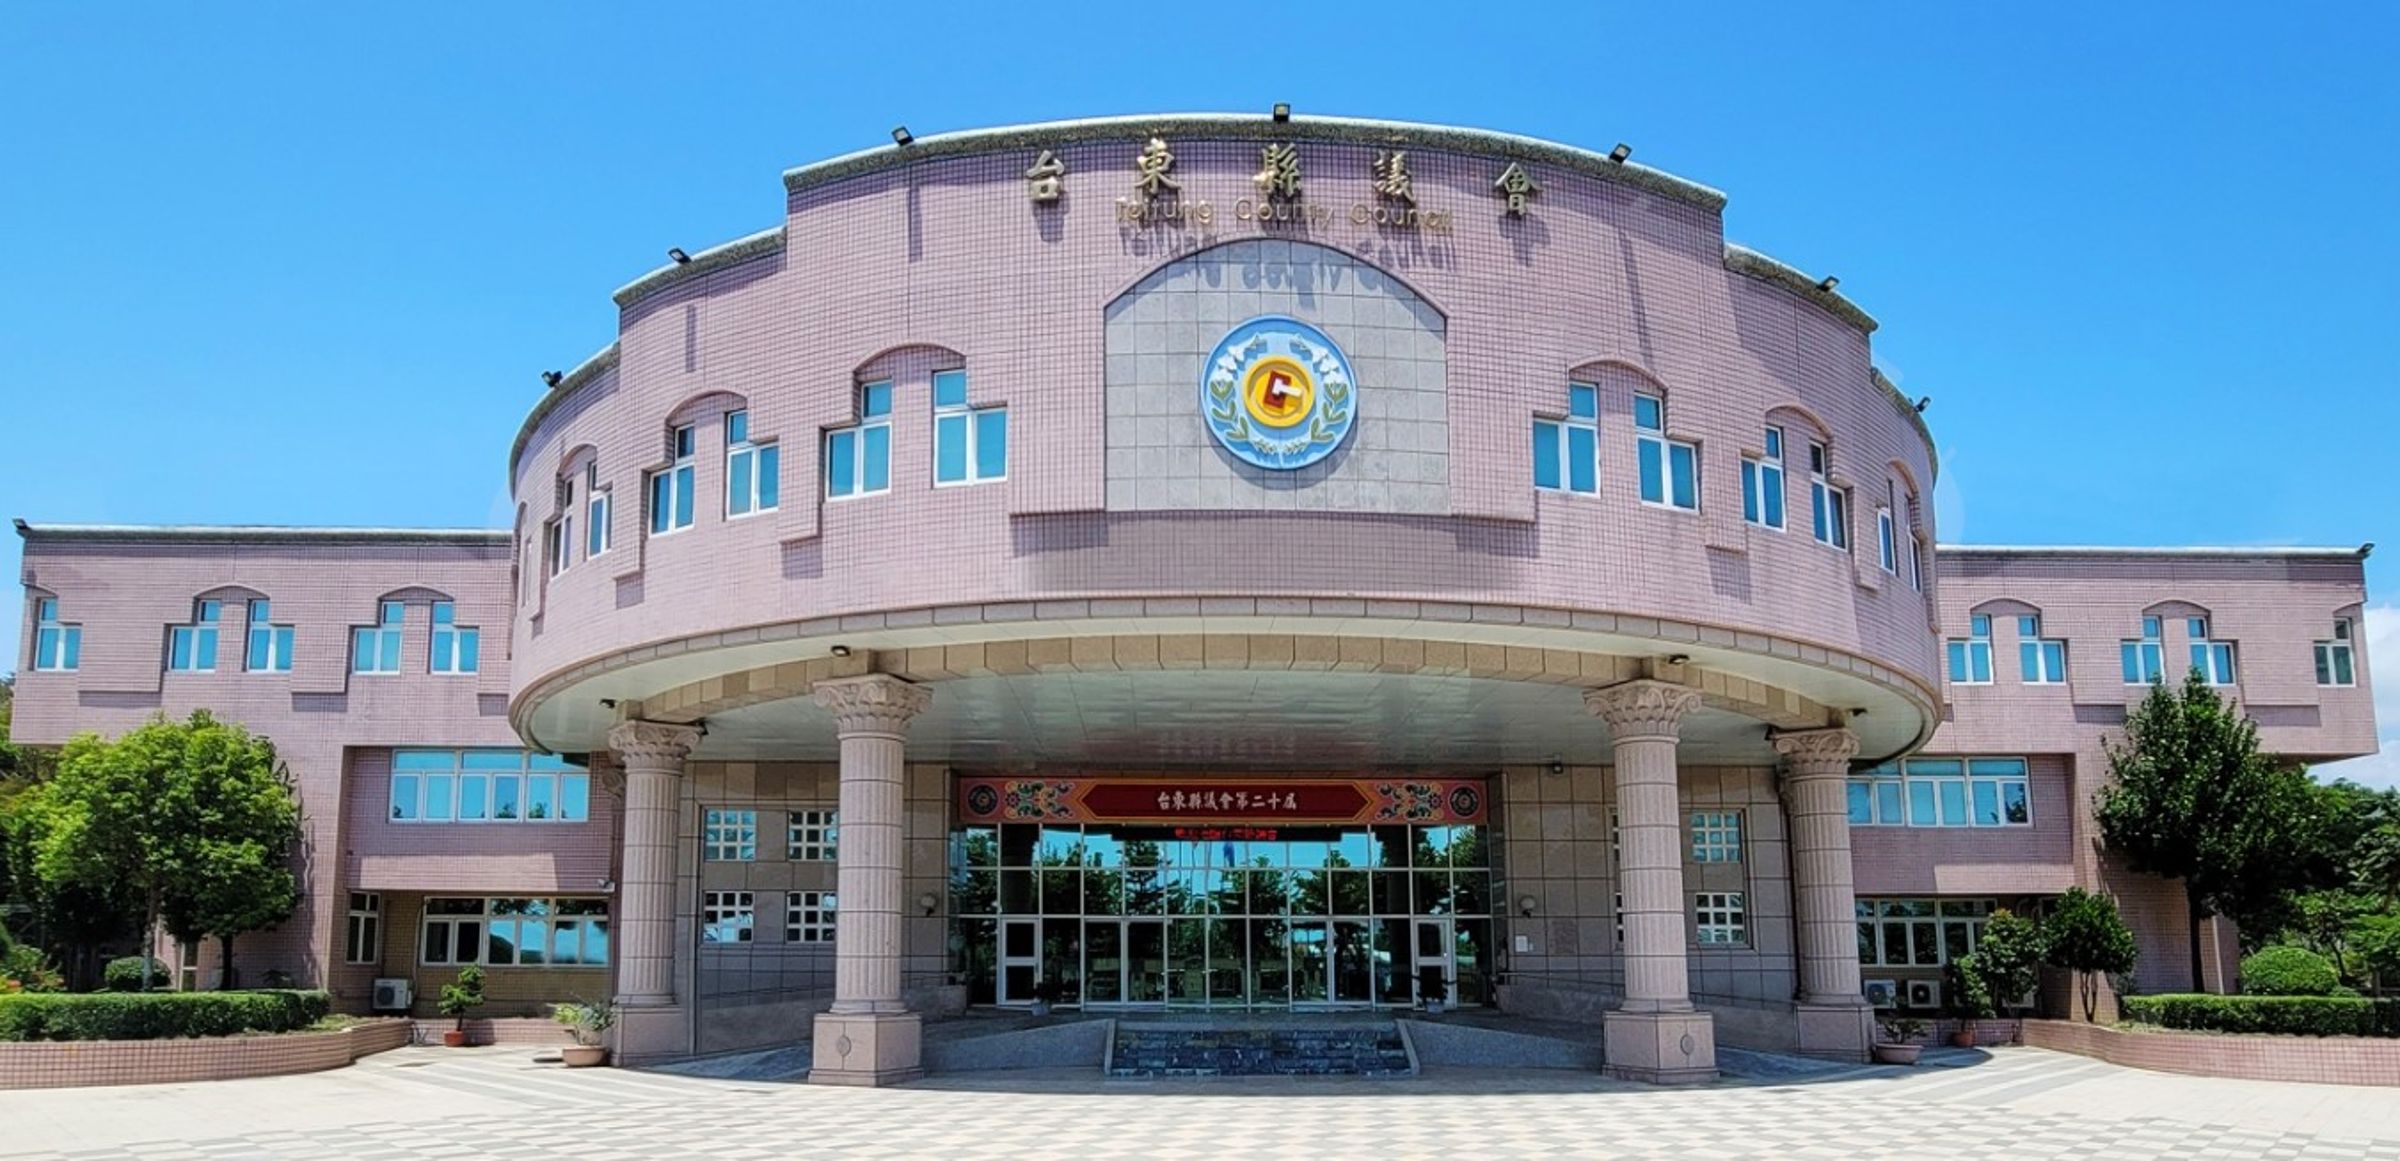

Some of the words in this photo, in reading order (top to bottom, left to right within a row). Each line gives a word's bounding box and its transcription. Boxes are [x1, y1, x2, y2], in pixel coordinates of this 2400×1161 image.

[1026, 138, 1542, 216] 台東縣議會
[1234, 196, 1334, 231] County
[1351, 204, 1452, 229] Council
[1157, 790, 1297, 811] 台東縣議會第二十屆
